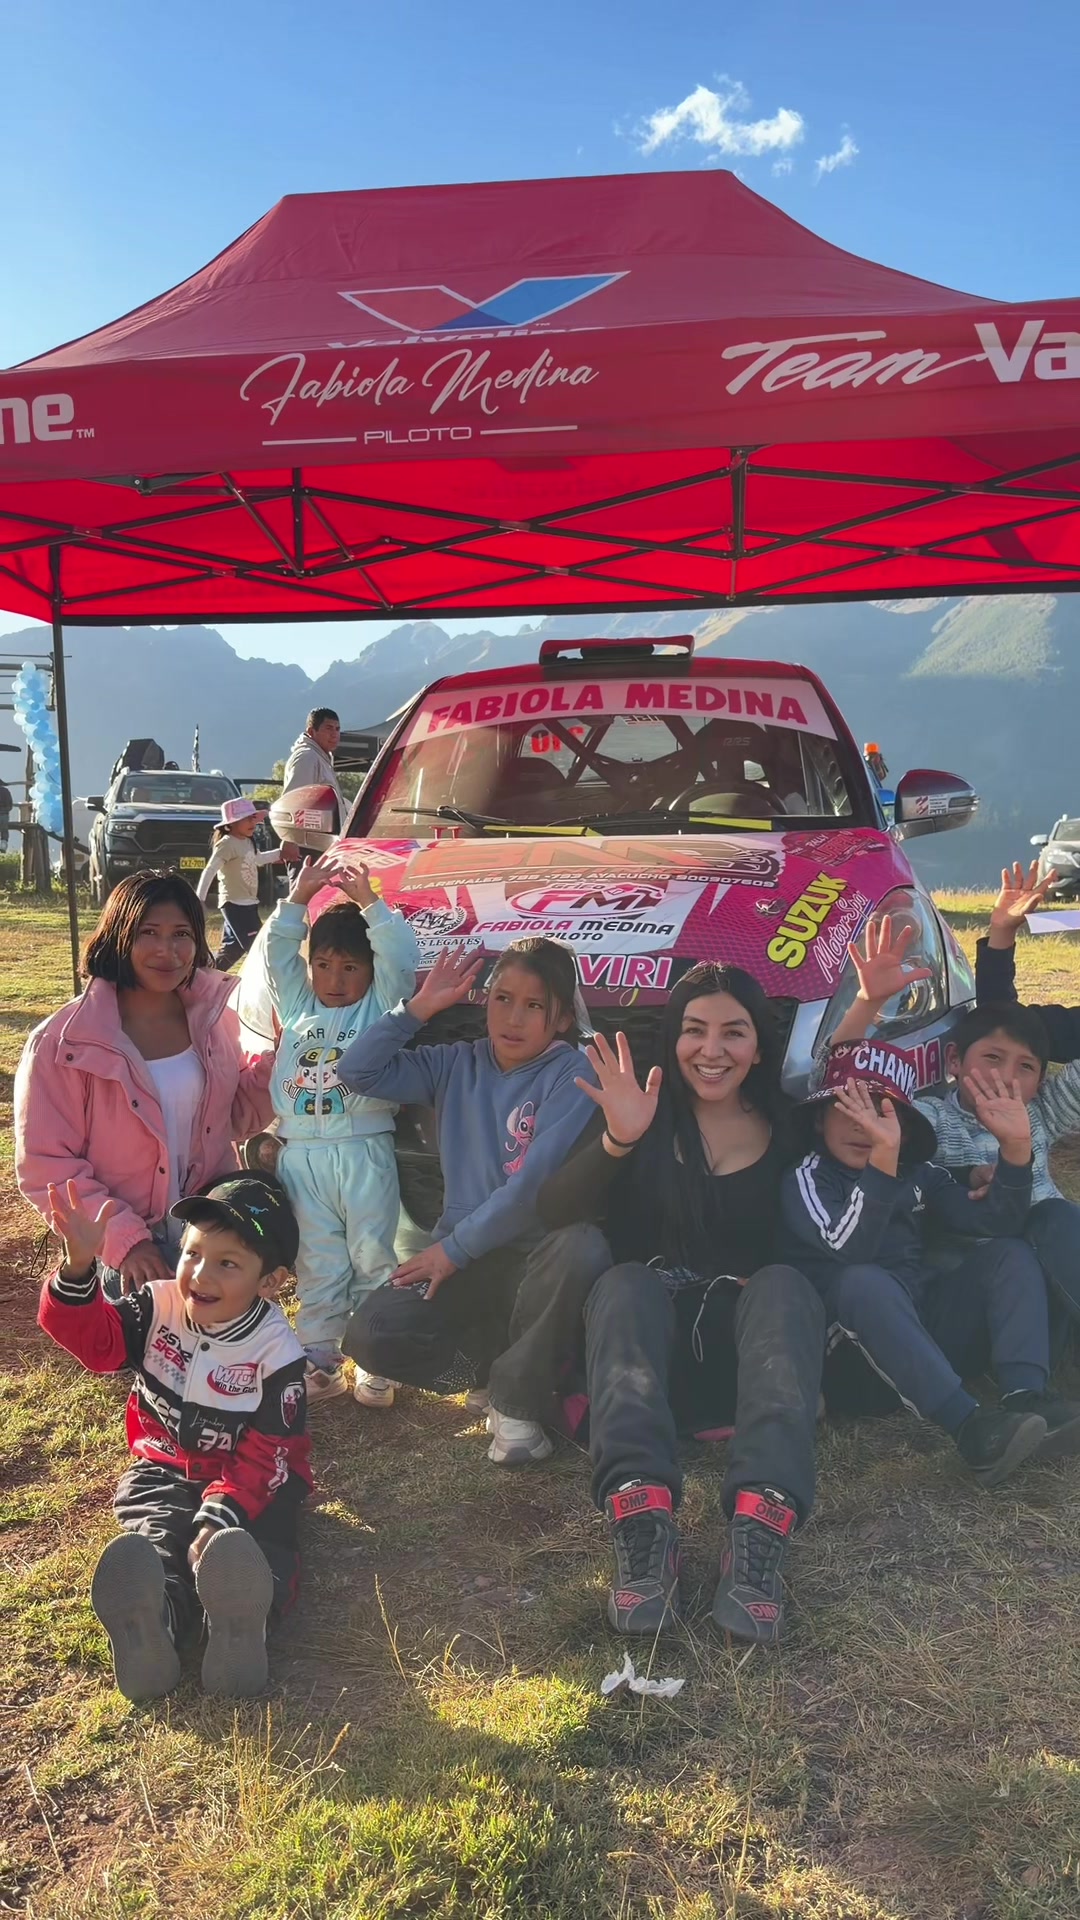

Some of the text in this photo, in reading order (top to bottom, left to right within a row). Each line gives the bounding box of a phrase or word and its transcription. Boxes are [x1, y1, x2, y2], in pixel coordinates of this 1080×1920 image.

[722, 330, 985, 395] Team
[240, 348, 600, 425] Fabiola Medina
[0, 393, 75, 445] ne
[363, 426, 473, 445] PILOTO
[428, 682, 809, 733] FABIOLA MEDINA
[425, 875, 503, 888] ARENALES
[585, 872, 671, 881] AYACUCHO
[529, 889, 663, 913] FM
[475, 919, 573, 933] FABIOLA
[578, 920, 675, 936] MEDINA
[766, 870, 848, 969] SUZUK
[428, 937, 483, 947] LEGALES
[228, 1384, 241, 1393] the
[619, 1491, 649, 1511] OMP
[755, 1503, 786, 1524] OMP
[615, 1593, 643, 1607] OMP
[749, 1604, 779, 1618] OMP
